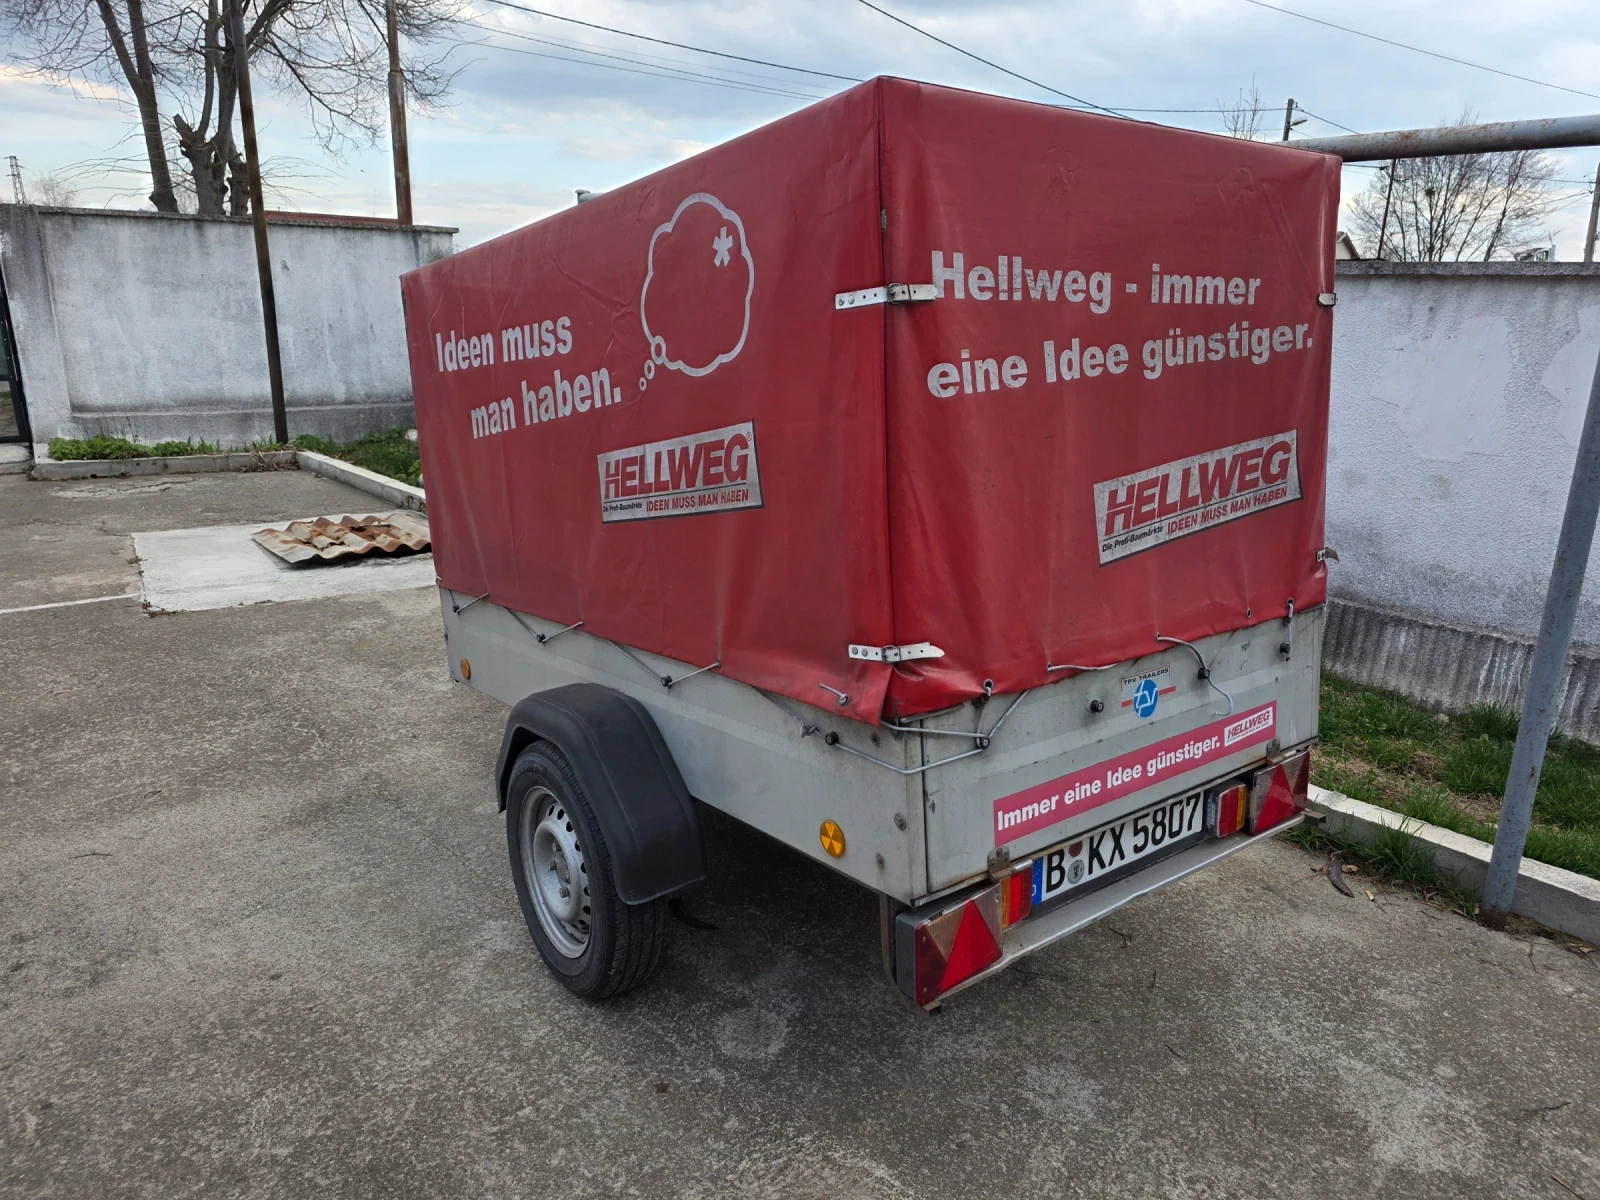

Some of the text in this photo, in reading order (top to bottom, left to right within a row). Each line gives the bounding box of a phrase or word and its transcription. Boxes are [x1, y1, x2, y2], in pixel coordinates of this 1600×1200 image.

[931, 250, 1112, 315] Hellweg
[1150, 263, 1262, 305] immer
[435, 316, 573, 372] Ideen muss
[927, 321, 1313, 398] eine Idee günstiger.
[471, 367, 622, 439] man haben.
[604, 433, 749, 500] HELLWEG
[1104, 440, 1292, 537] HELLWEG
[609, 502, 642, 513] Profi-Baumärkte
[646, 500, 669, 512] IDEEN
[672, 496, 696, 510] MUSS
[698, 493, 718, 507] MAN
[721, 488, 749, 504] HABEN
[1102, 487, 1287, 553] Die Profi-Baumärkte IDEEN MUSS MAN HABEN
[1124, 667, 1169, 685] TPV TRAILERS
[1227, 710, 1270, 739] HELLWEG
[997, 735, 1220, 831] Immer eine Idee günstiger.
[1046, 791, 1201, 893] B KX 5807
